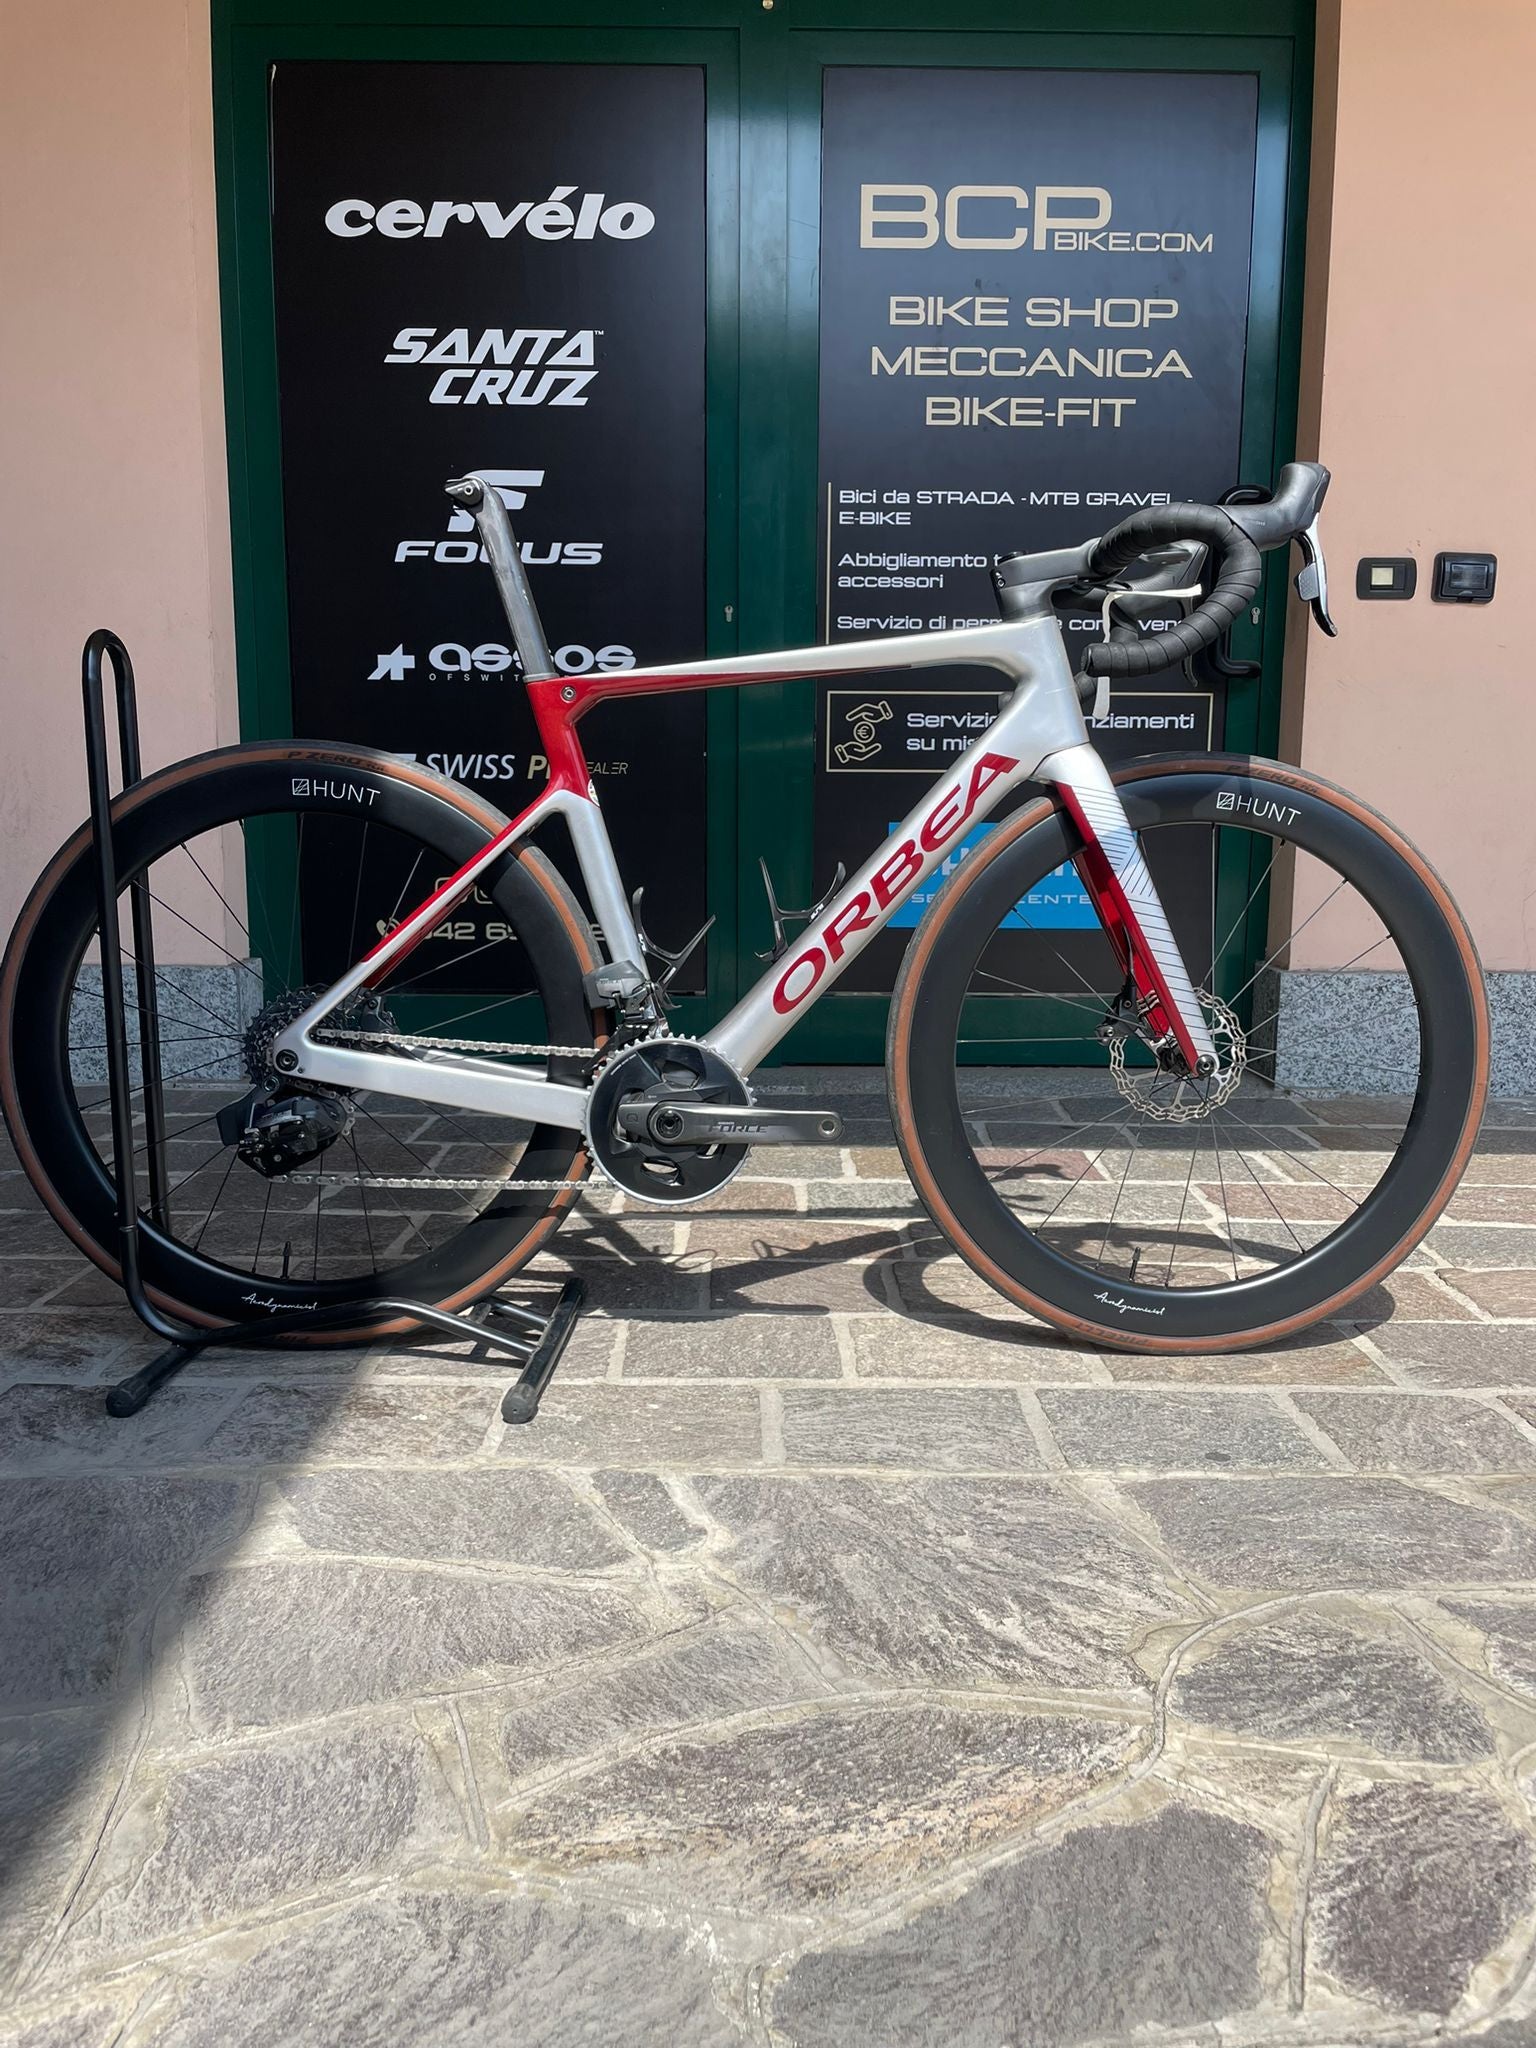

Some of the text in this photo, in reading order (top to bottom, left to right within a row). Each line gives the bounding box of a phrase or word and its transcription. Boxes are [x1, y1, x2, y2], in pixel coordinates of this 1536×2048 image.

[325, 186, 655, 240] cervélo
[860, 184, 1214, 253] BCP BIKE.COM
[889, 296, 1180, 328] BIKE SHOP
[384, 328, 595, 366] SANTA
[871, 347, 1193, 378] MECCANICA
[429, 369, 600, 406] CRUZ
[925, 396, 1137, 427] BIKE-FIT
[839, 490, 877, 504] Bici
[883, 491, 910, 504] da
[916, 491, 1015, 505] STRADA
[839, 511, 911, 526] E-BIKE
[838, 553, 987, 571] Abbigliamento
[838, 574, 944, 589] accessori
[837, 615, 923, 630] Servizio
[929, 615, 946, 630] di
[906, 738, 936, 751] su
[426, 753, 515, 780] SWISS
[313, 780, 380, 806] HUNT
[1236, 795, 1301, 826] HUNT
[772, 751, 1021, 1015] ORBEA
